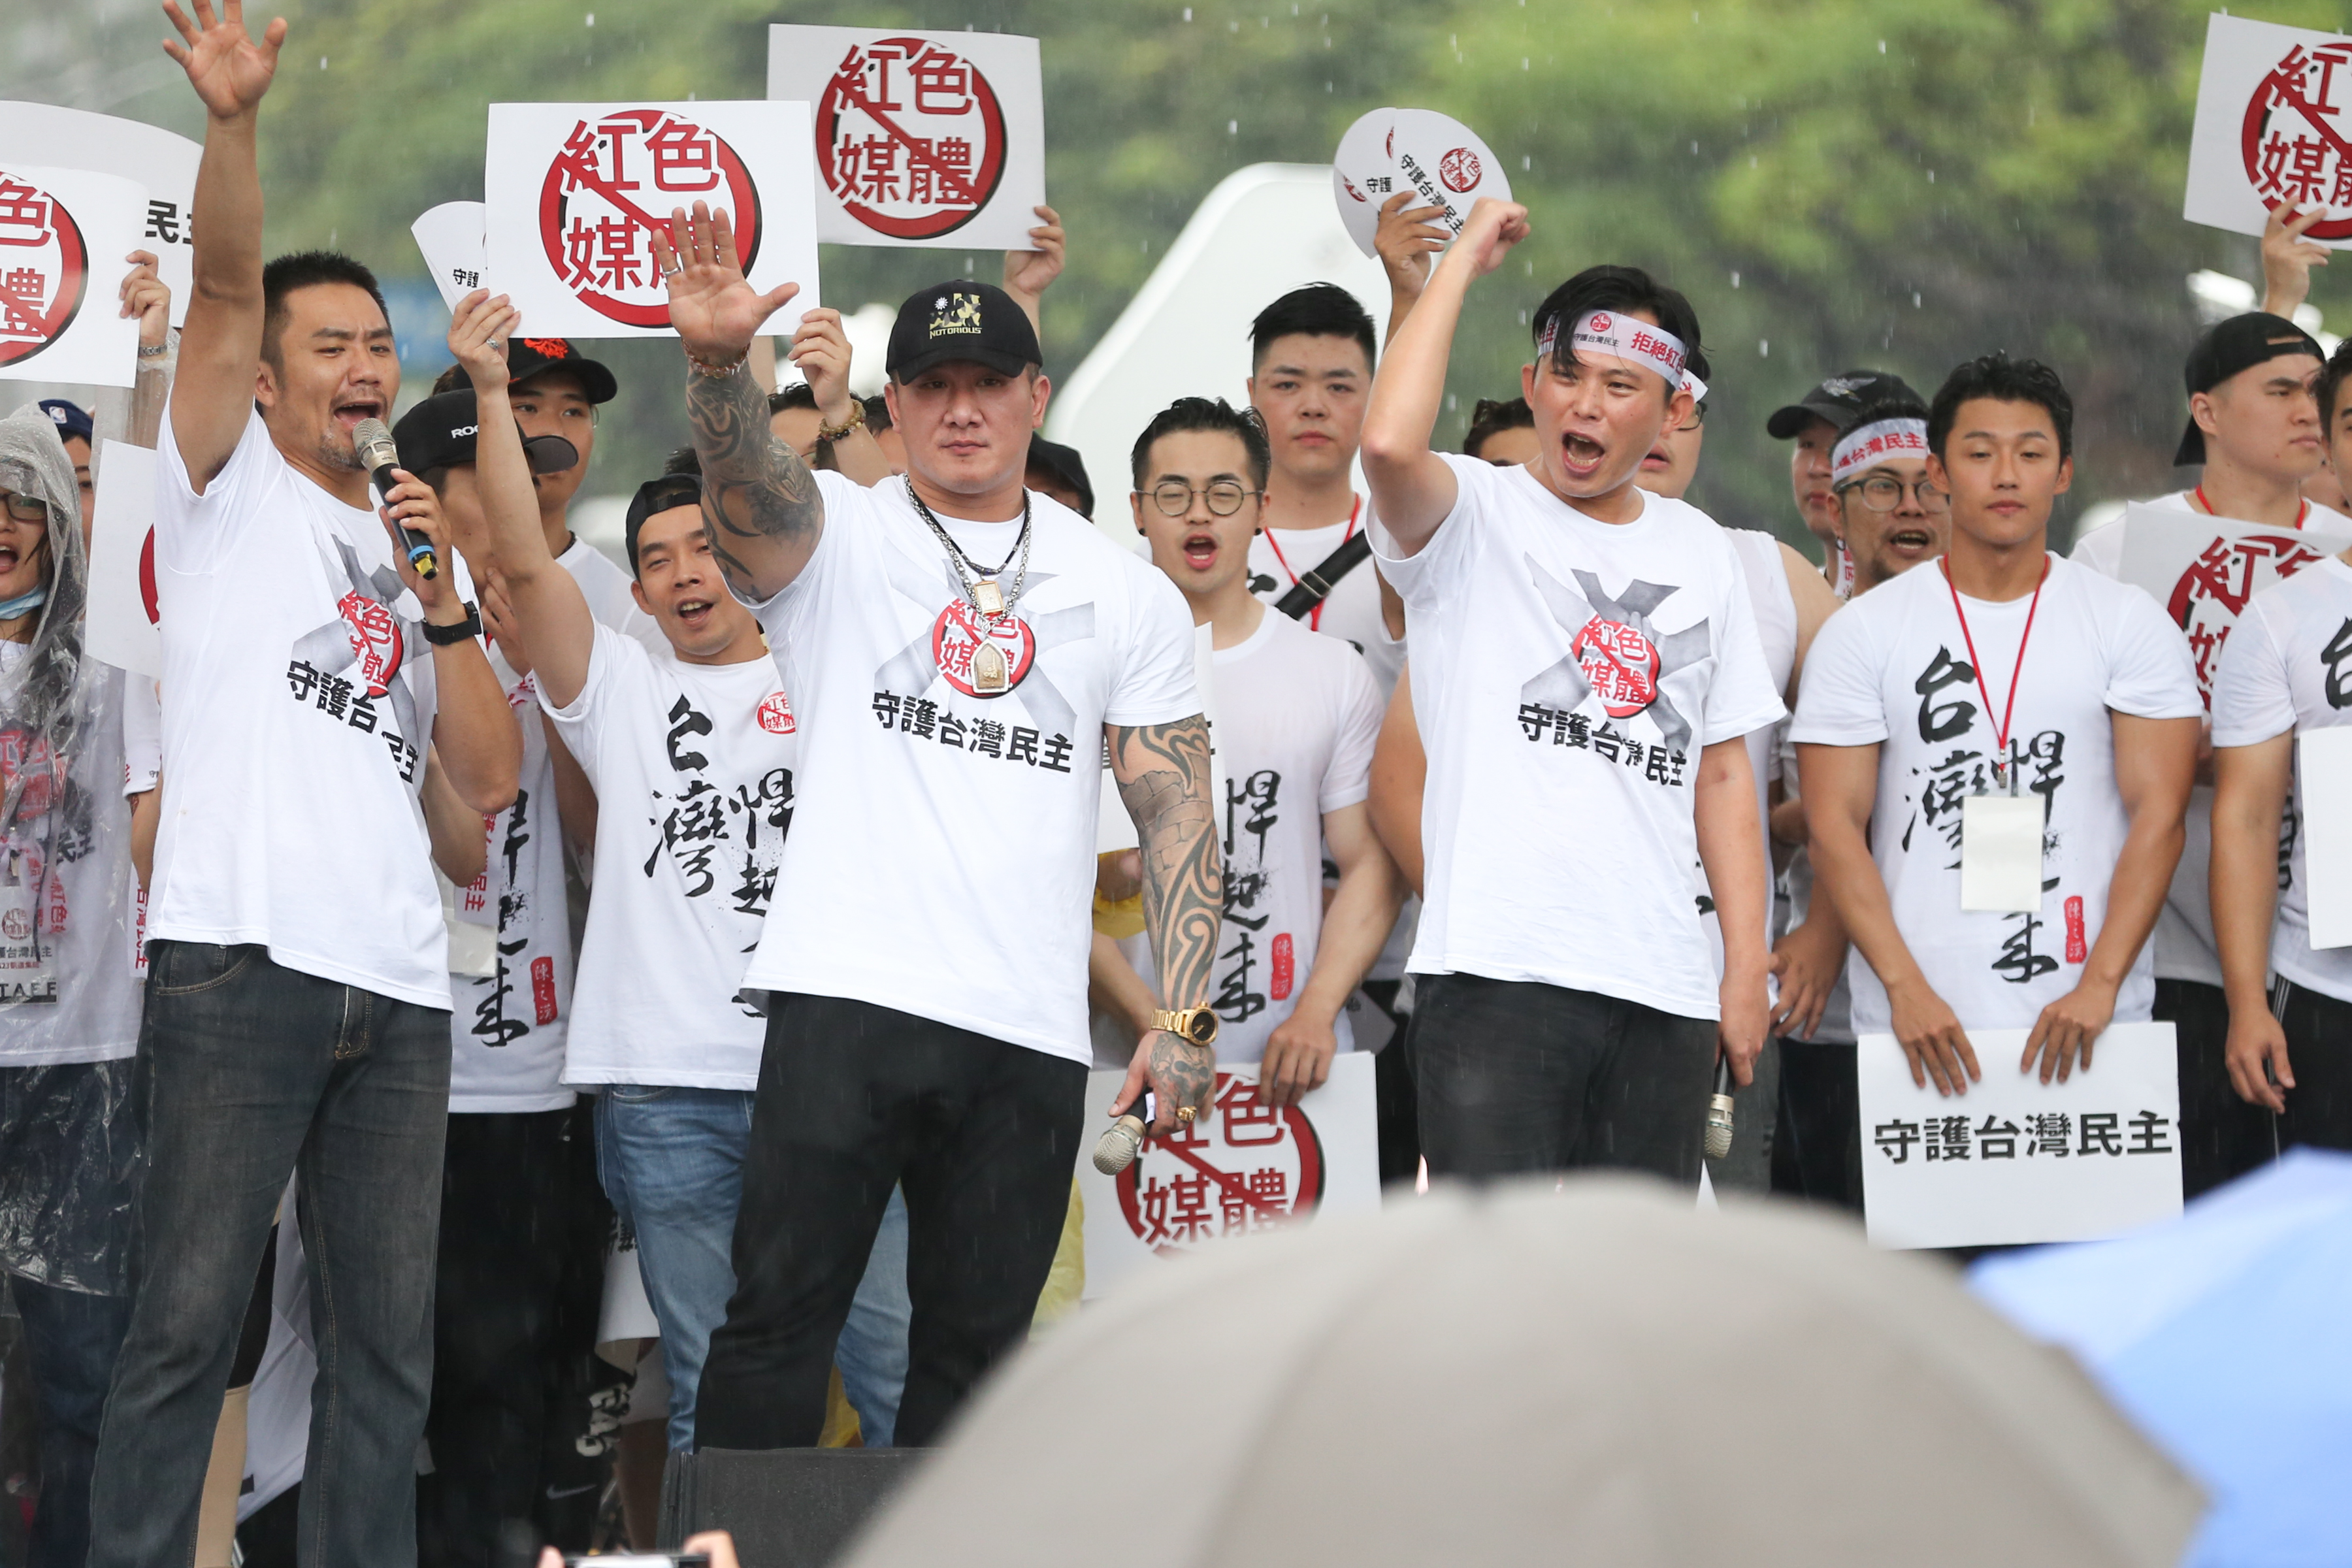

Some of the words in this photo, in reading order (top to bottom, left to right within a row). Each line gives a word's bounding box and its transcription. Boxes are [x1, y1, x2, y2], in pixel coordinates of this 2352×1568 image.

[836, 44, 975, 115] 紅色
[559, 118, 720, 193] 紅色
[838, 133, 979, 205] 媒體
[1367, 176, 1392, 193] 守護
[144, 199, 195, 244] 民
[453, 268, 480, 288] 守護
[565, 216, 724, 291] 媒
[930, 327, 983, 340] NOTORIOUS
[1573, 333, 1620, 348] 守護台灣民主
[1586, 613, 1648, 662] 紅色
[872, 689, 1074, 774] 守護台灣民主
[644, 693, 729, 898] 台灣
[1874, 1110, 2173, 1164] 守護台灣民主
[1142, 1168, 1291, 1244] 媒體
